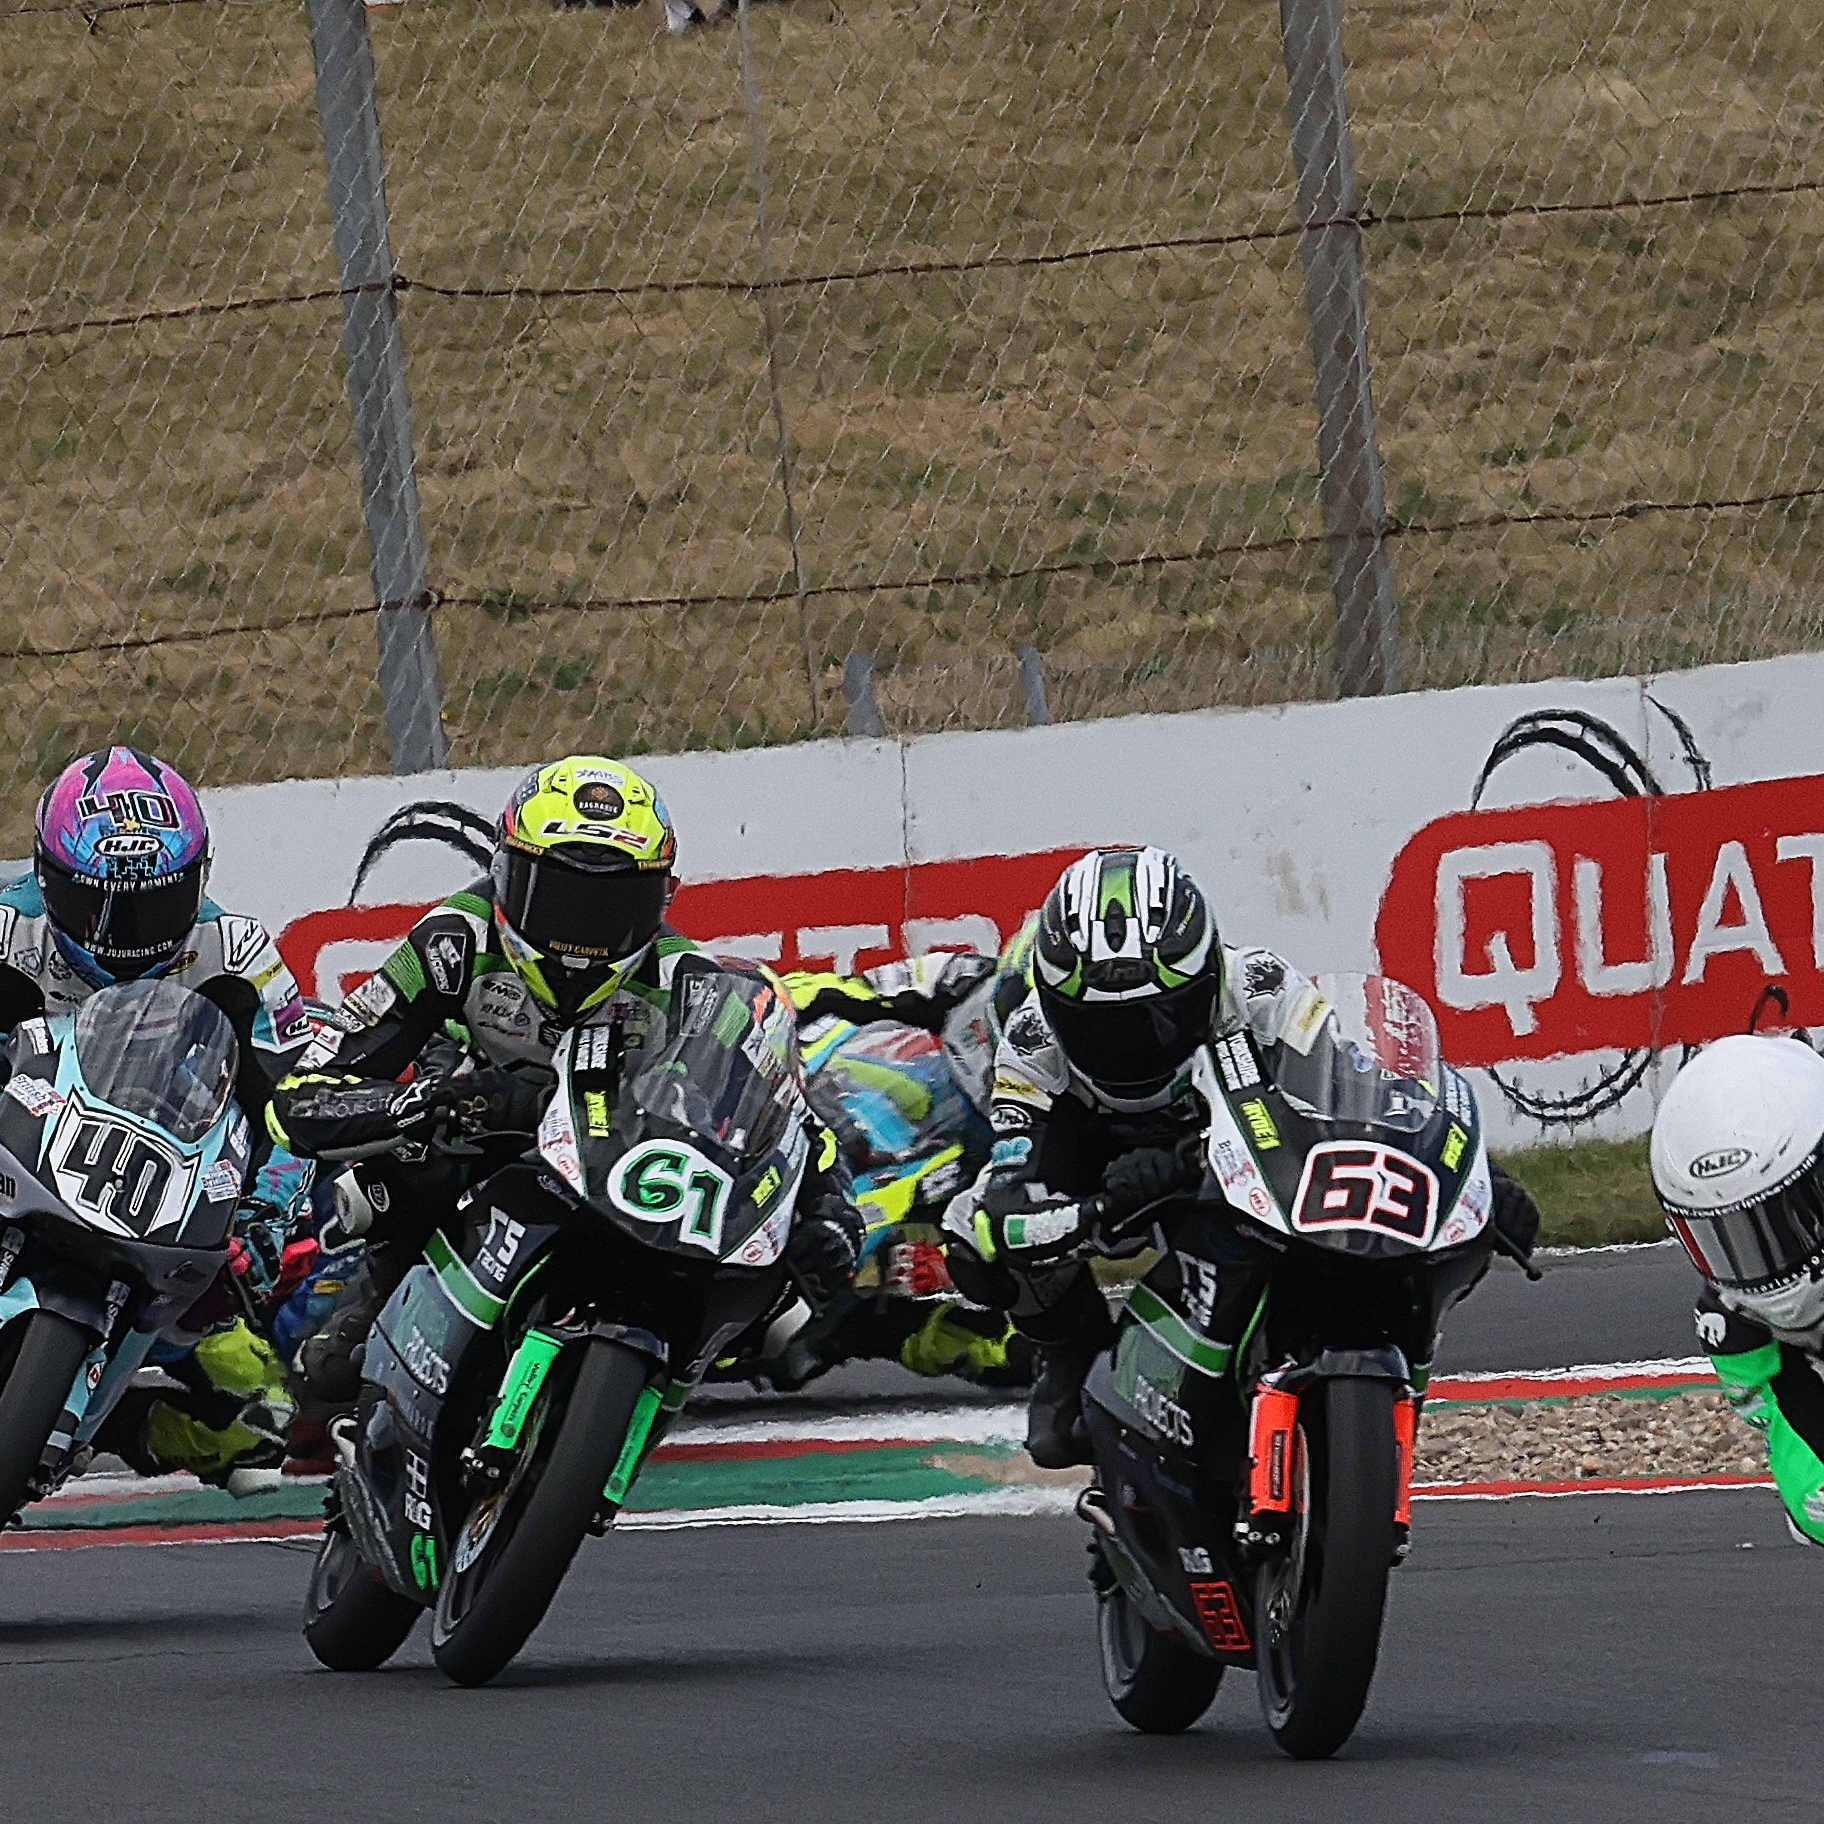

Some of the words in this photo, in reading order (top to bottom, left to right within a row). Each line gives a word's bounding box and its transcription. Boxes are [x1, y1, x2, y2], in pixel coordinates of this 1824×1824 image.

[77, 788, 180, 830] 40
[103, 839, 156, 853] HJC
[542, 820, 649, 851] LS2
[61, 1120, 174, 1238] 40
[1696, 1150, 1747, 1174] HJC
[622, 1148, 724, 1239] 61
[1299, 1149, 1431, 1240] 63
